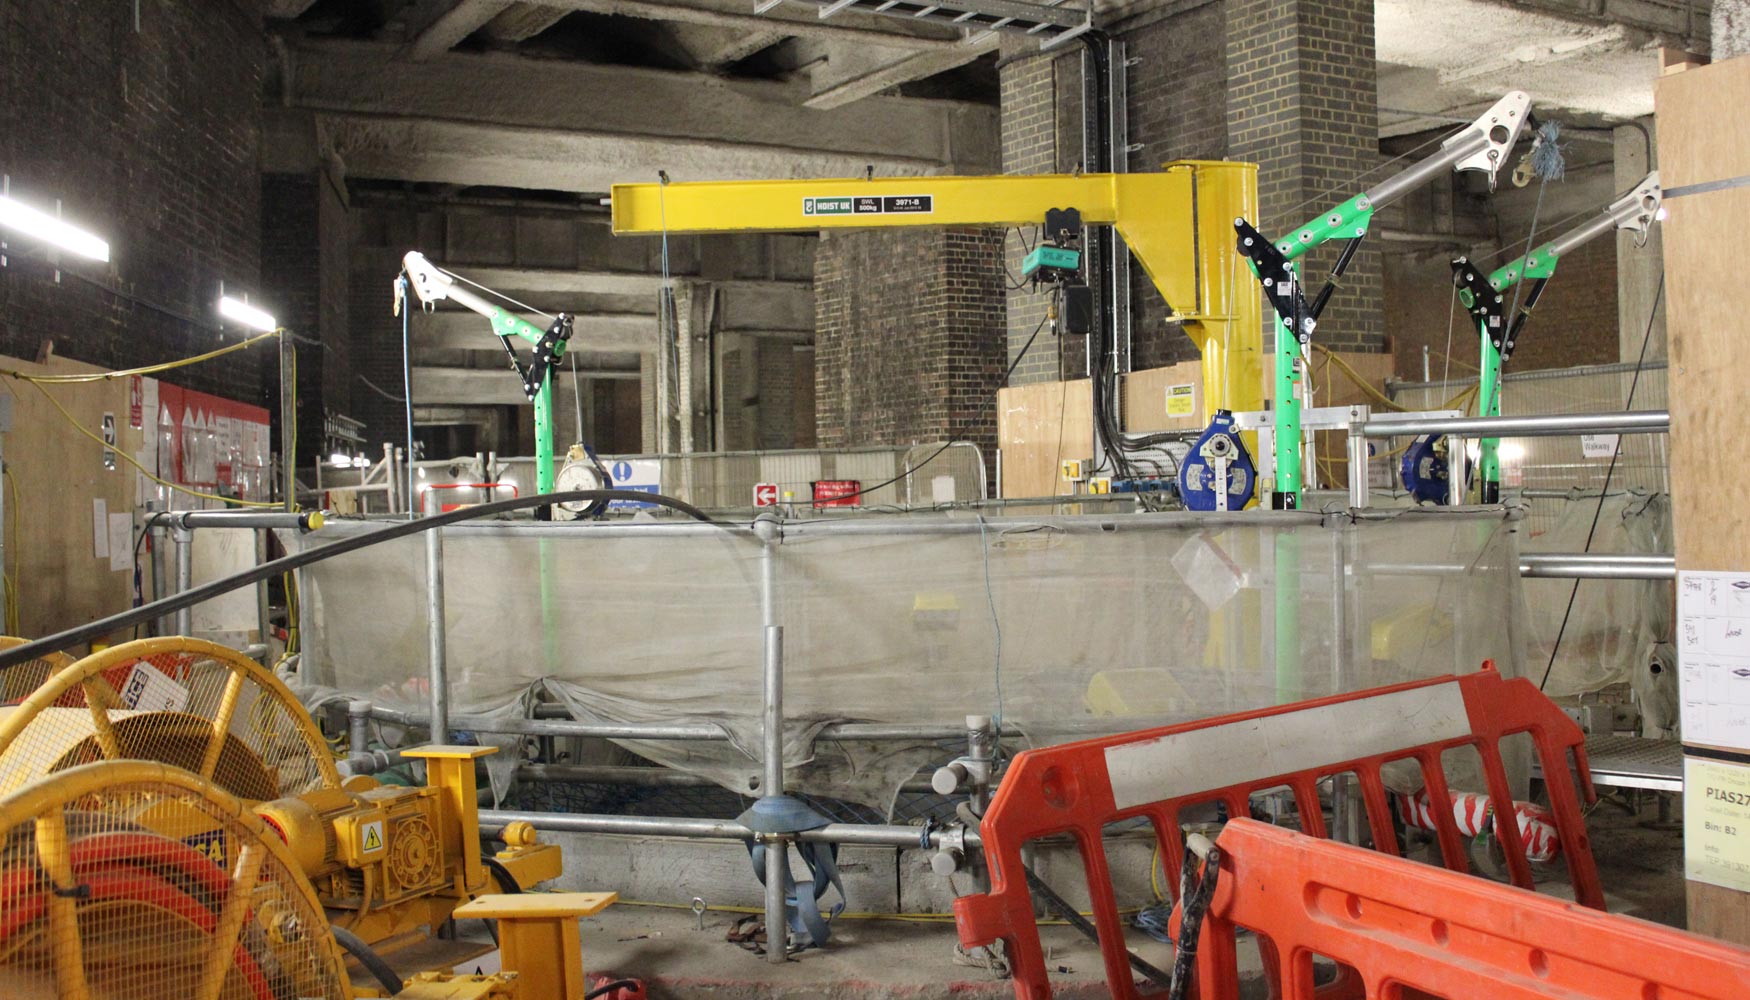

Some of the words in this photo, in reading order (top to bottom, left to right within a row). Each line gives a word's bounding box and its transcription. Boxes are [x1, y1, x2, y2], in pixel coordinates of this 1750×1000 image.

[817, 202, 839, 210] HOIST
[840, 202, 850, 210] UK
[859, 204, 877, 212] 500kg
[1585, 443, 1610, 452] Walkway
[1725, 825, 1737, 836] B2
